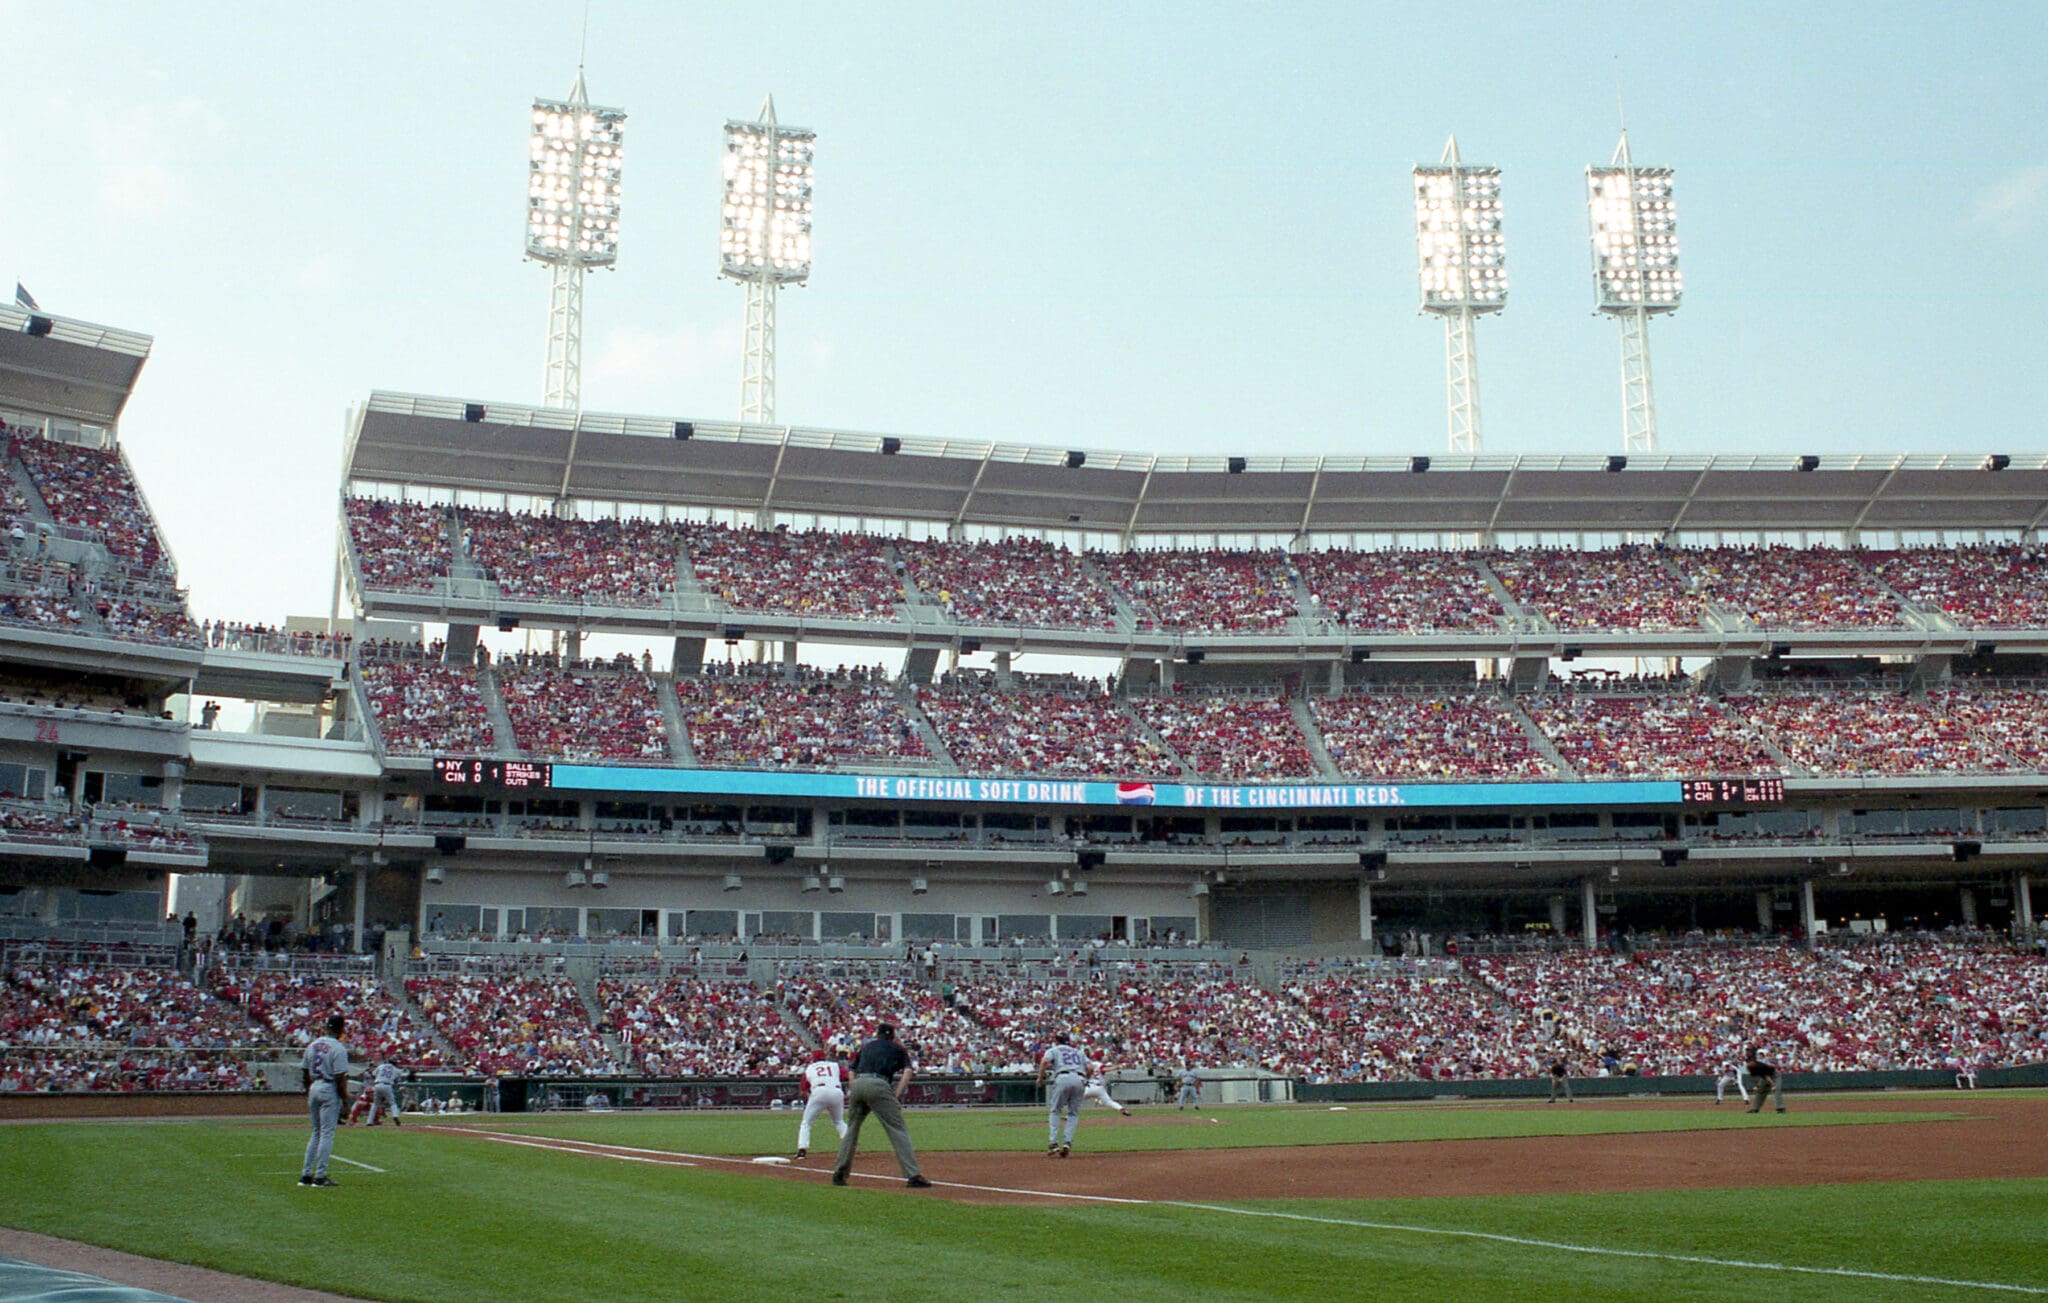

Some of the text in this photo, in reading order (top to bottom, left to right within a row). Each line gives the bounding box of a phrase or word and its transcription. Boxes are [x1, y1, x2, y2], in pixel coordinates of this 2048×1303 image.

[445, 761, 482, 771] NY 0
[506, 763, 533, 771] BALLS
[445, 772, 481, 783] CIN 0
[492, 768, 498, 778] 1
[506, 771, 541, 780] STRIKES
[506, 778, 550, 787] OUTS 2
[1694, 782, 1714, 790] STL
[856, 778, 1084, 801] THE OFFICIAL SOFT DRINK
[1186, 787, 1404, 805] OF THE CINCINNATI REDS.
[1695, 792, 1713, 800] CHI
[313, 1054, 323, 1074] 2
[1062, 1053, 1081, 1065] 20
[816, 1066, 832, 1077] 21
